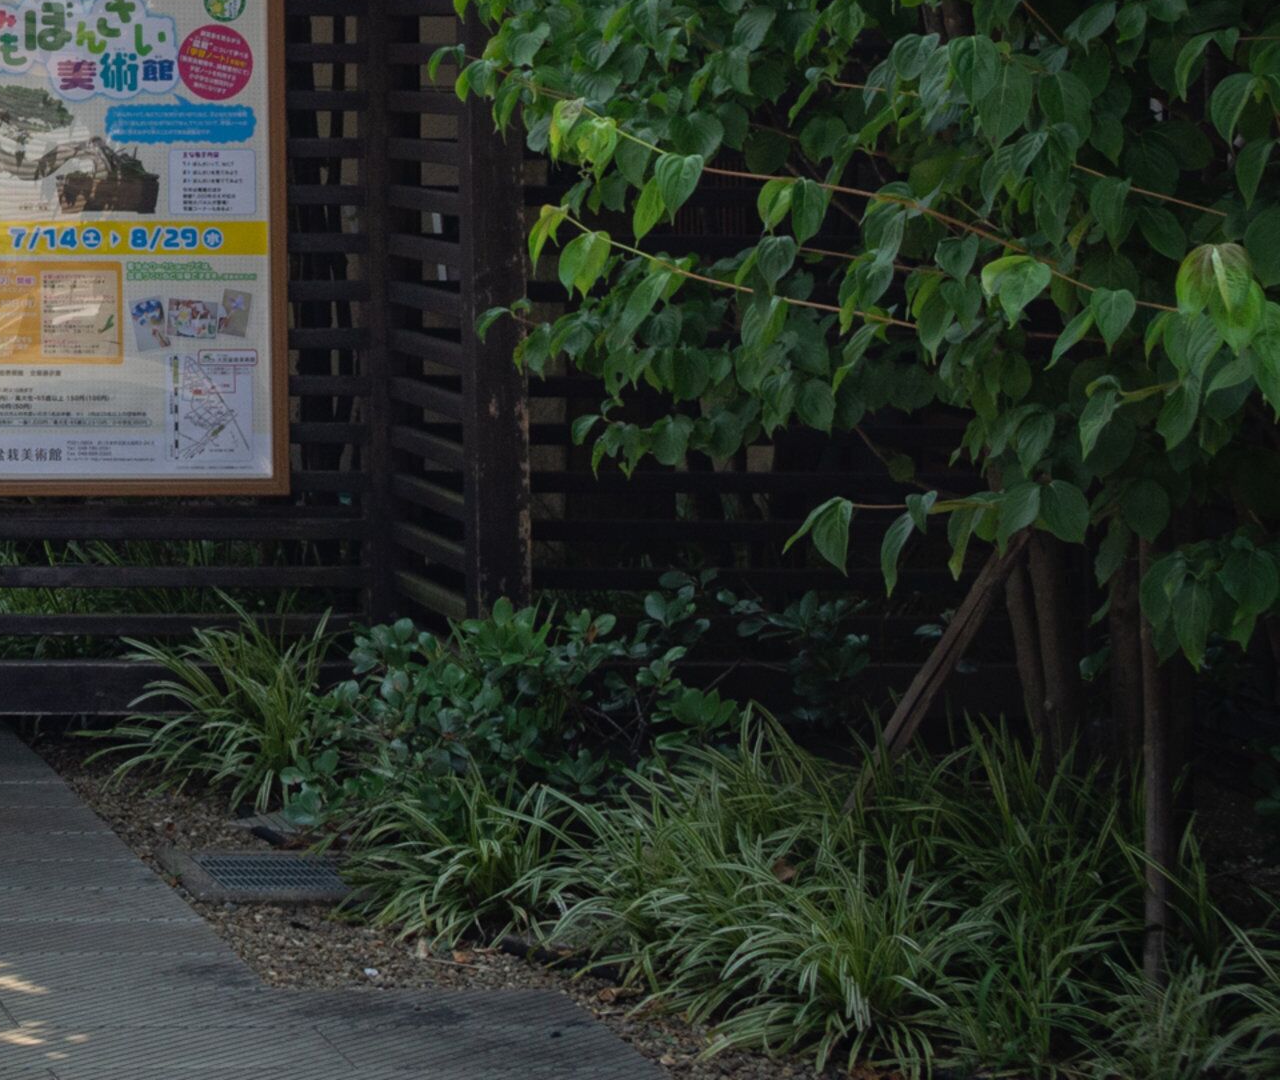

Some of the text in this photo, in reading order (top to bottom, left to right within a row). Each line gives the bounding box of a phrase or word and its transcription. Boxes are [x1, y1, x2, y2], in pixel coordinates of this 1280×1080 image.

[57, 52, 174, 91] 美術館
[10, 228, 77, 249] 7/14
[130, 228, 197, 249] 8/29
